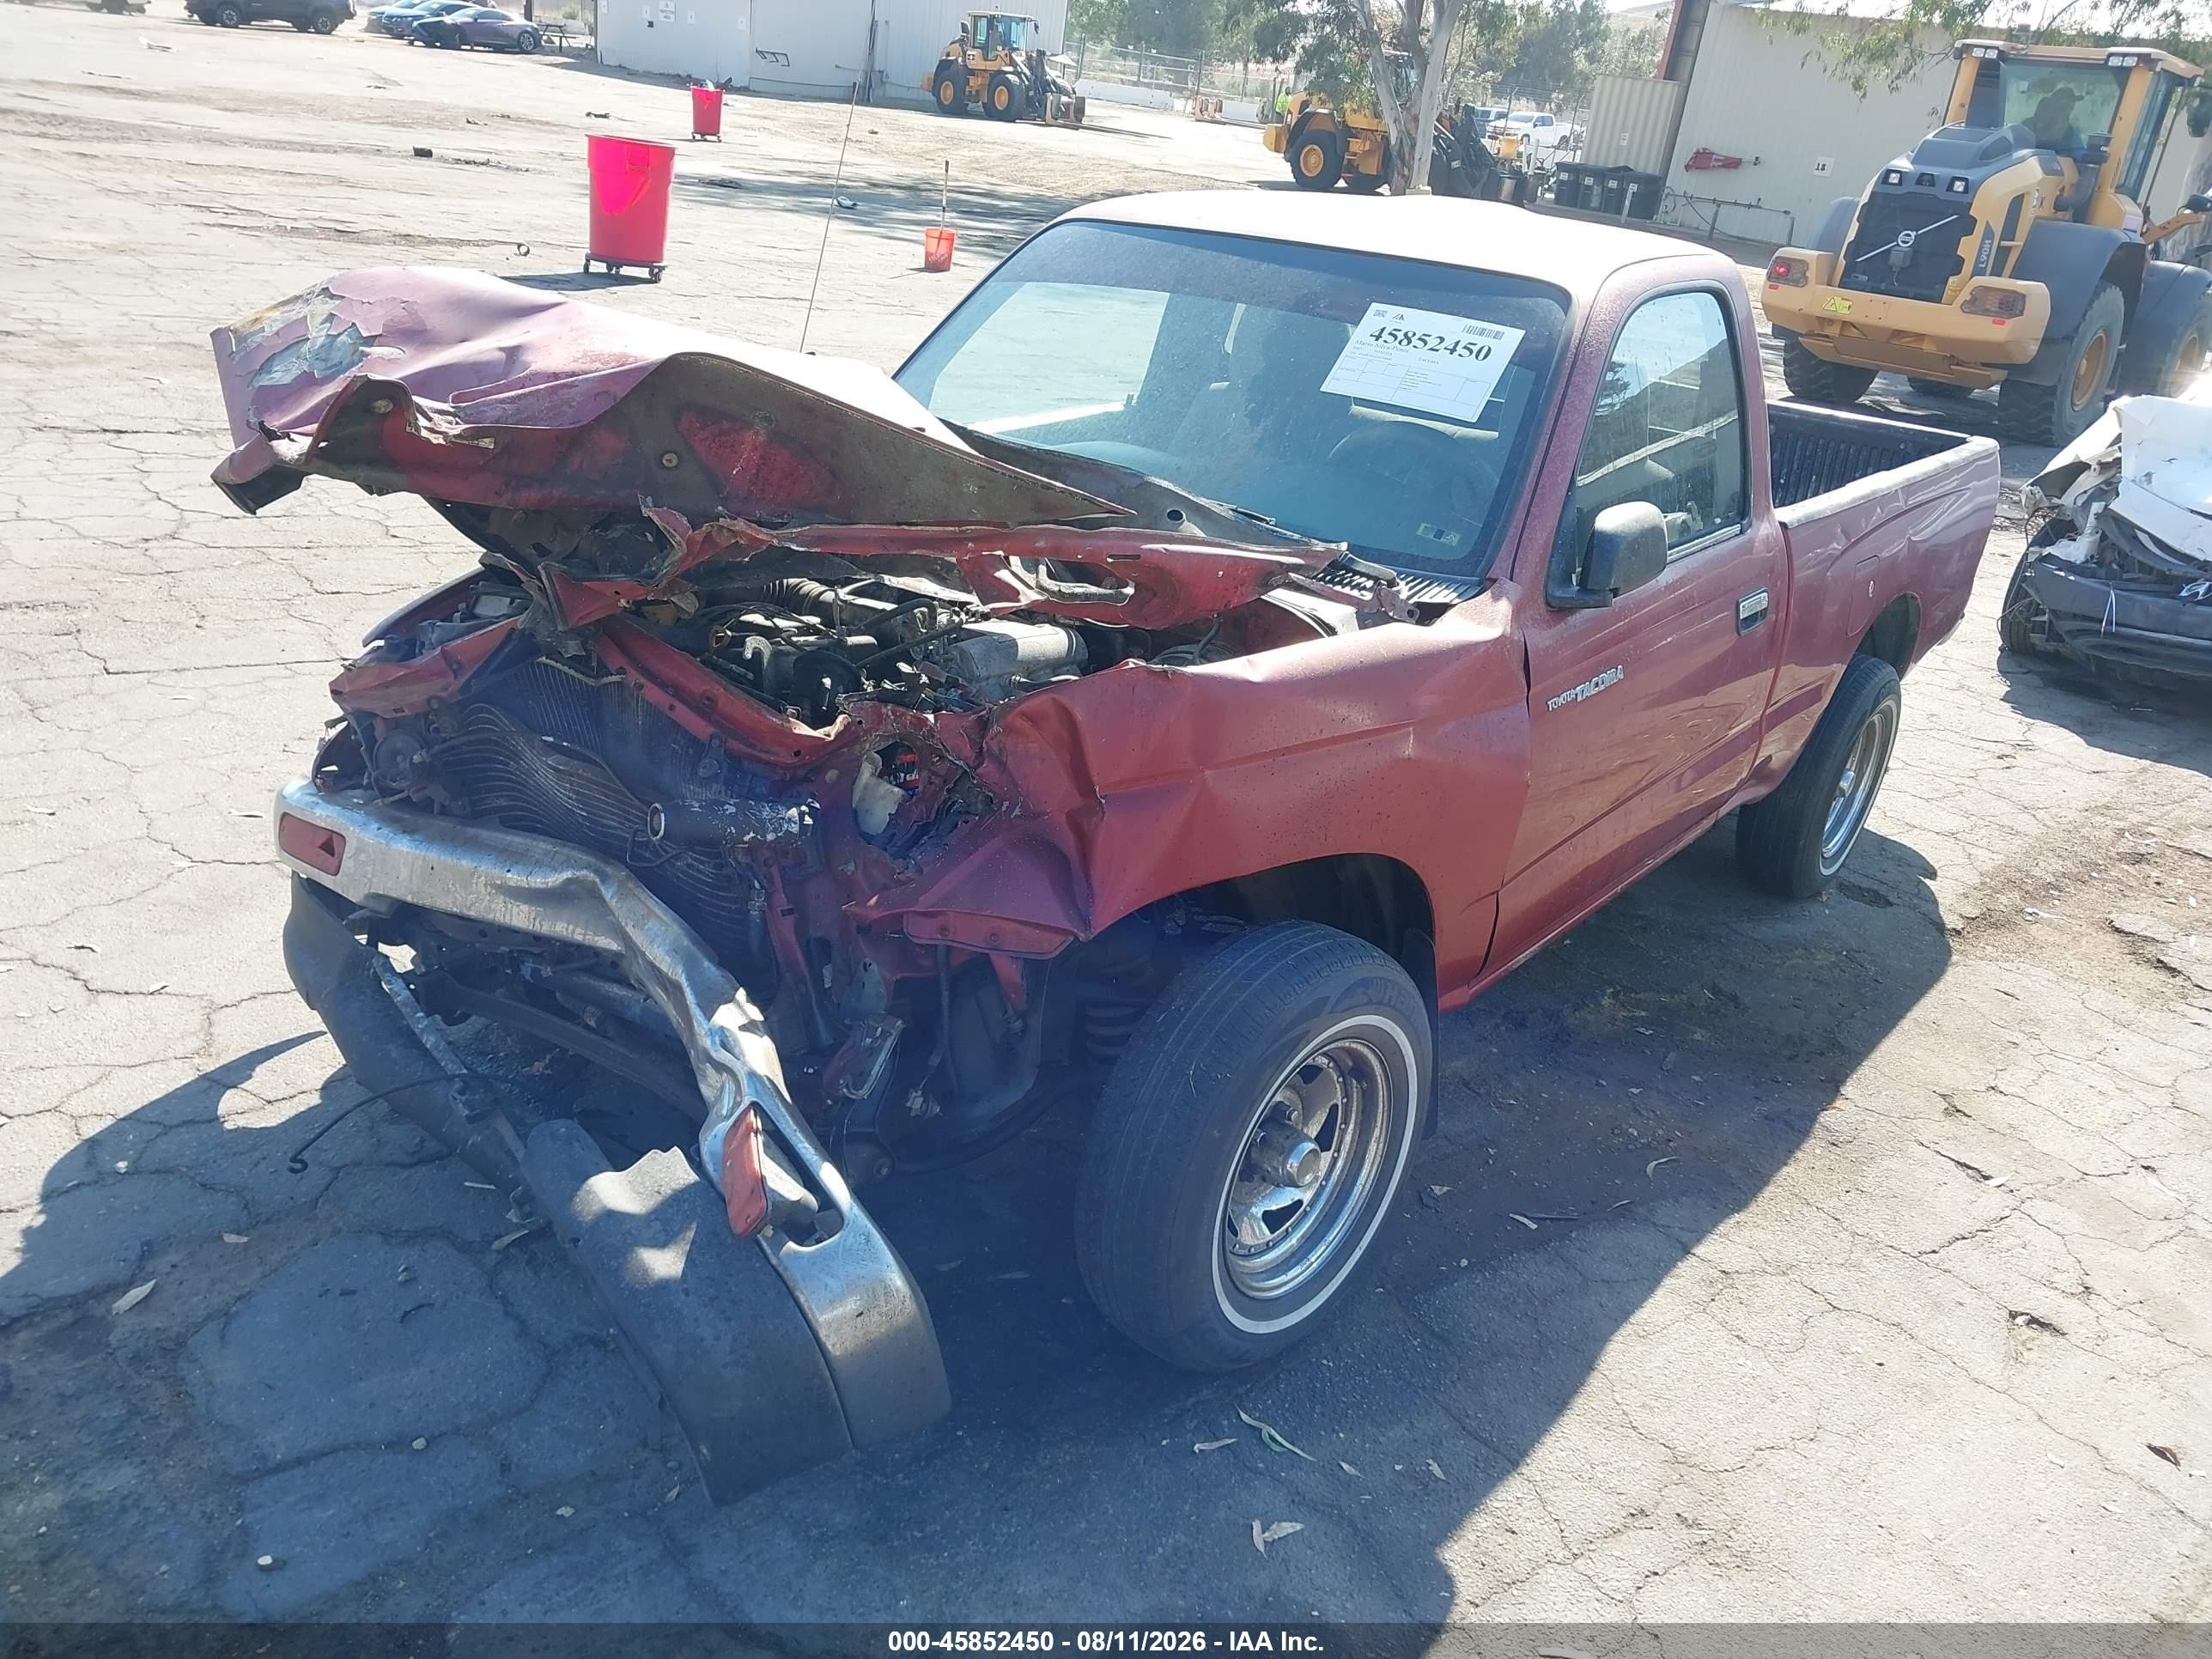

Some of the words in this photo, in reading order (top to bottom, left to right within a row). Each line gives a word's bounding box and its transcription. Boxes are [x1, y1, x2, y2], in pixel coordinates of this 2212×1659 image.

[1814, 161, 1827, 172] 18
[1978, 240, 1991, 268] L90H
[1369, 326, 1492, 362] 45852450
[1547, 689, 1576, 711] TOYOTA
[1575, 665, 1625, 702] TACOMA
